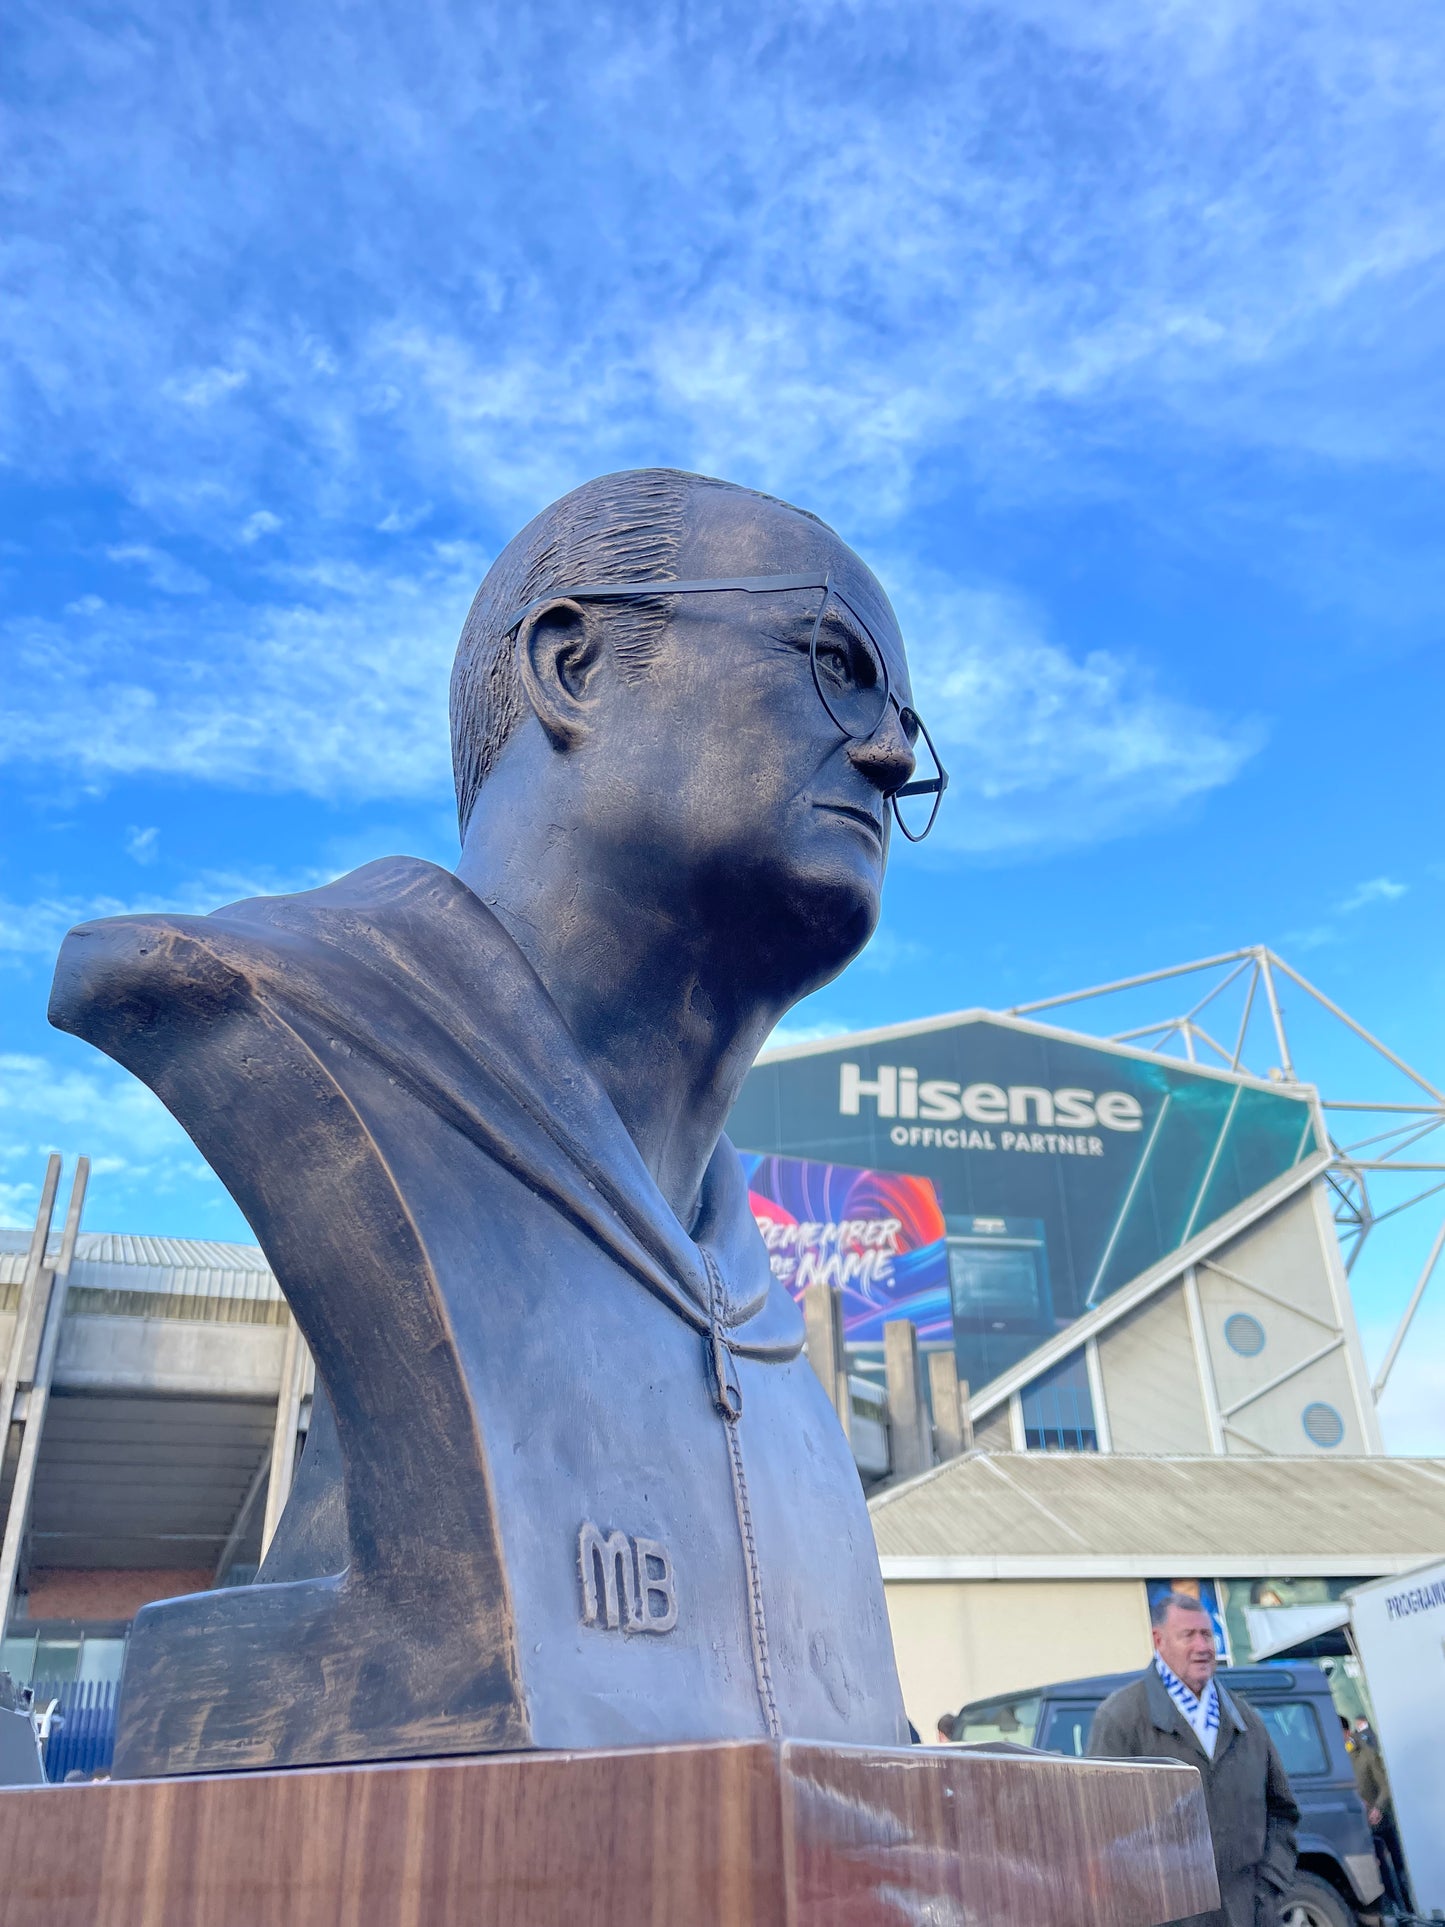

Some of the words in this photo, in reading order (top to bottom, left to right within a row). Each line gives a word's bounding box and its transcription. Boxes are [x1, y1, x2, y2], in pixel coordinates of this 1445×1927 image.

[839, 1062, 1143, 1132] Hisense
[890, 1126, 997, 1151] OFFICIAL
[1001, 1129, 1104, 1157] PARTNER
[577, 1520, 679, 1634] MB
